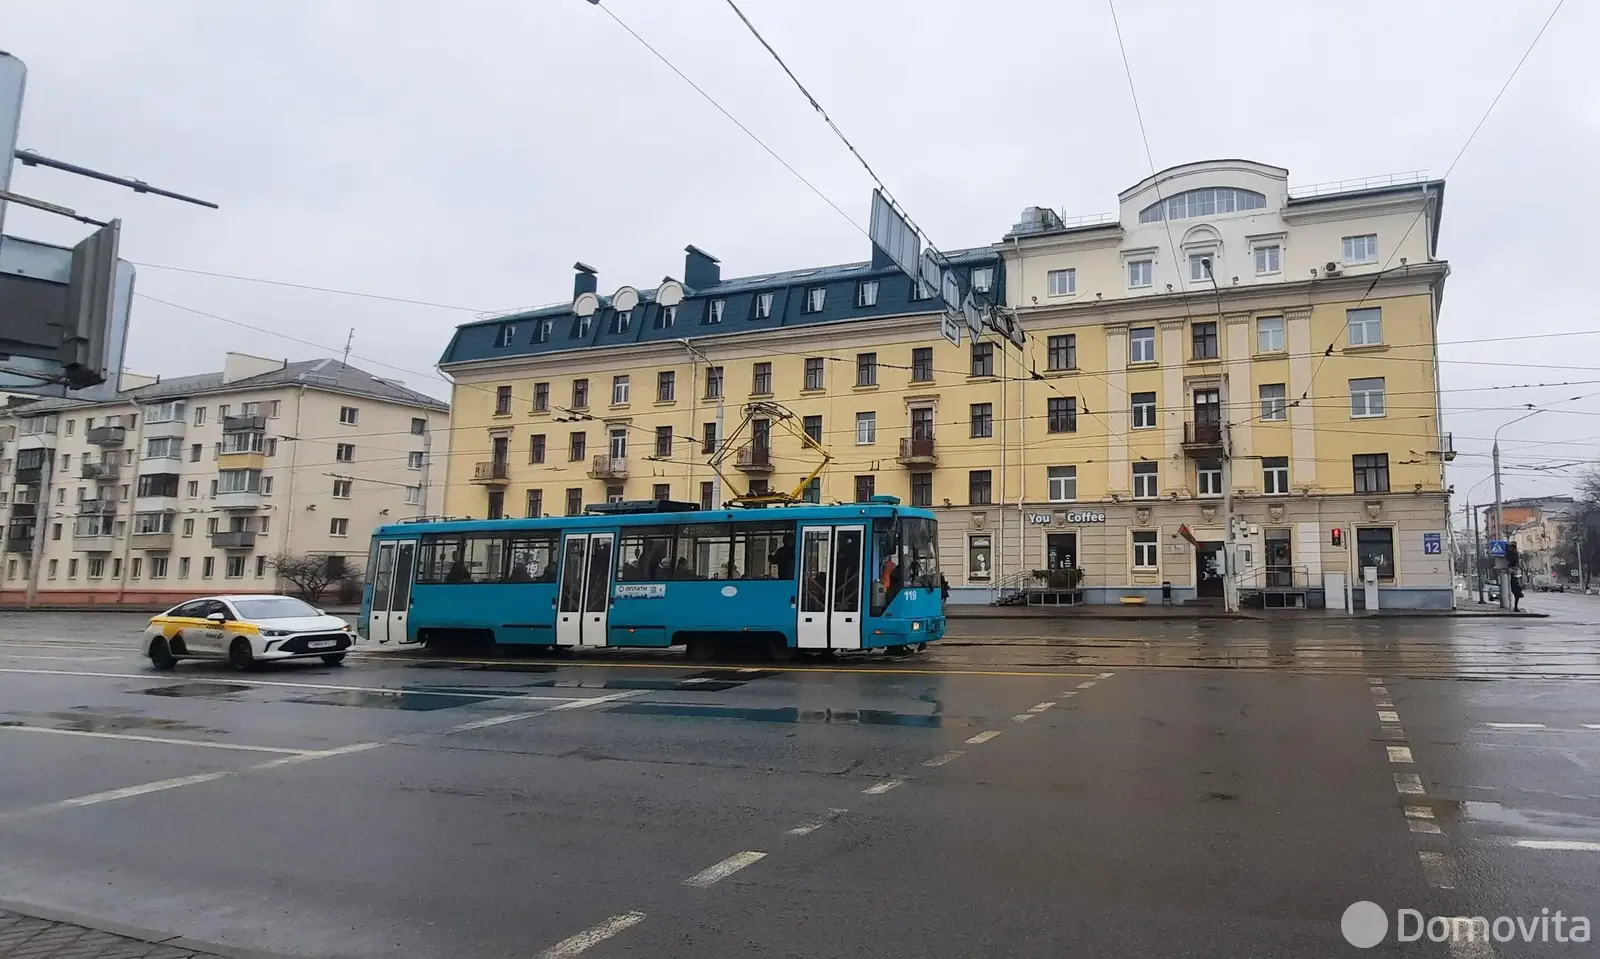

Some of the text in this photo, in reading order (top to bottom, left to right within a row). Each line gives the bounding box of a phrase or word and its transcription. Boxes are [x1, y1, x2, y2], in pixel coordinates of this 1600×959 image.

[1029, 511, 1106, 524] You Coffee
[1425, 542, 1440, 553] 12
[903, 590, 917, 601] 119
